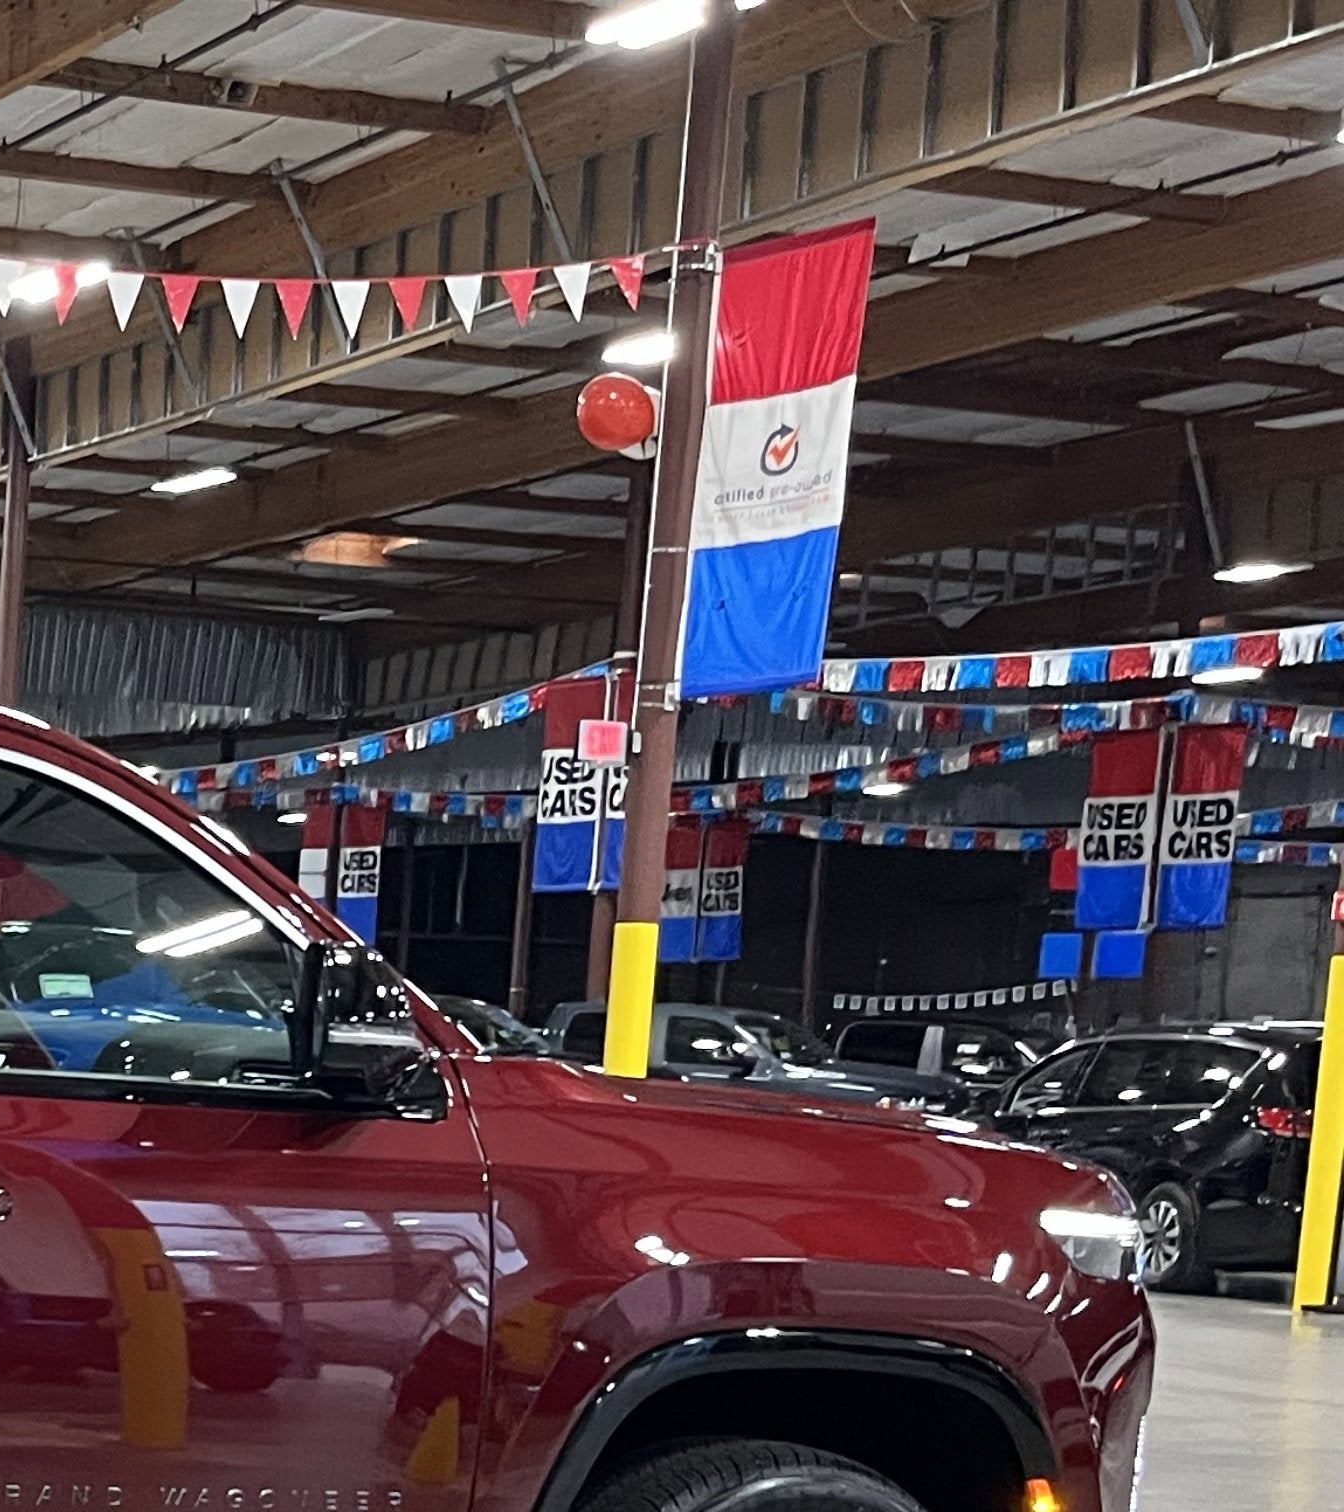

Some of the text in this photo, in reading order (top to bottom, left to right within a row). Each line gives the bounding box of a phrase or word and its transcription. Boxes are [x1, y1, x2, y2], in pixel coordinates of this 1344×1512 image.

[1088, 802, 1147, 830] USED
[1083, 833, 1144, 861] CARS
[1168, 829, 1232, 859] CARS
